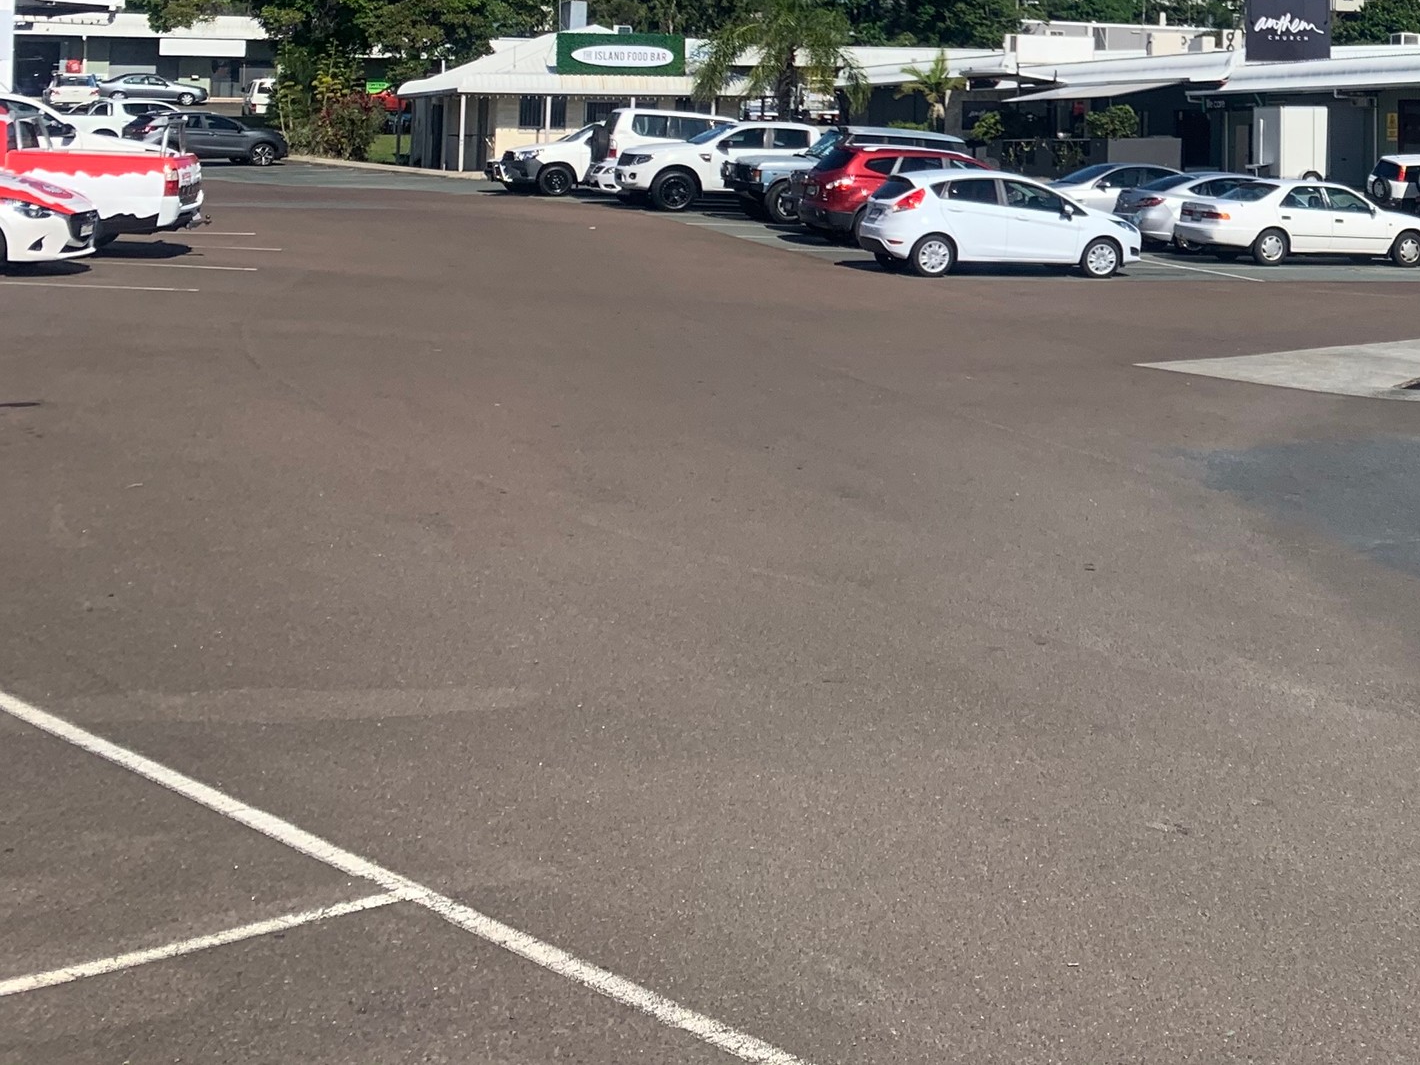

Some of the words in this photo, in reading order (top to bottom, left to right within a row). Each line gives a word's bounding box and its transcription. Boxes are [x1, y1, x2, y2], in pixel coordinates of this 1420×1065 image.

[1254, 13, 1325, 35] anthem
[594, 51, 625, 61] ISLAND
[627, 51, 648, 61] FOOD
[650, 52, 667, 61] BAR
